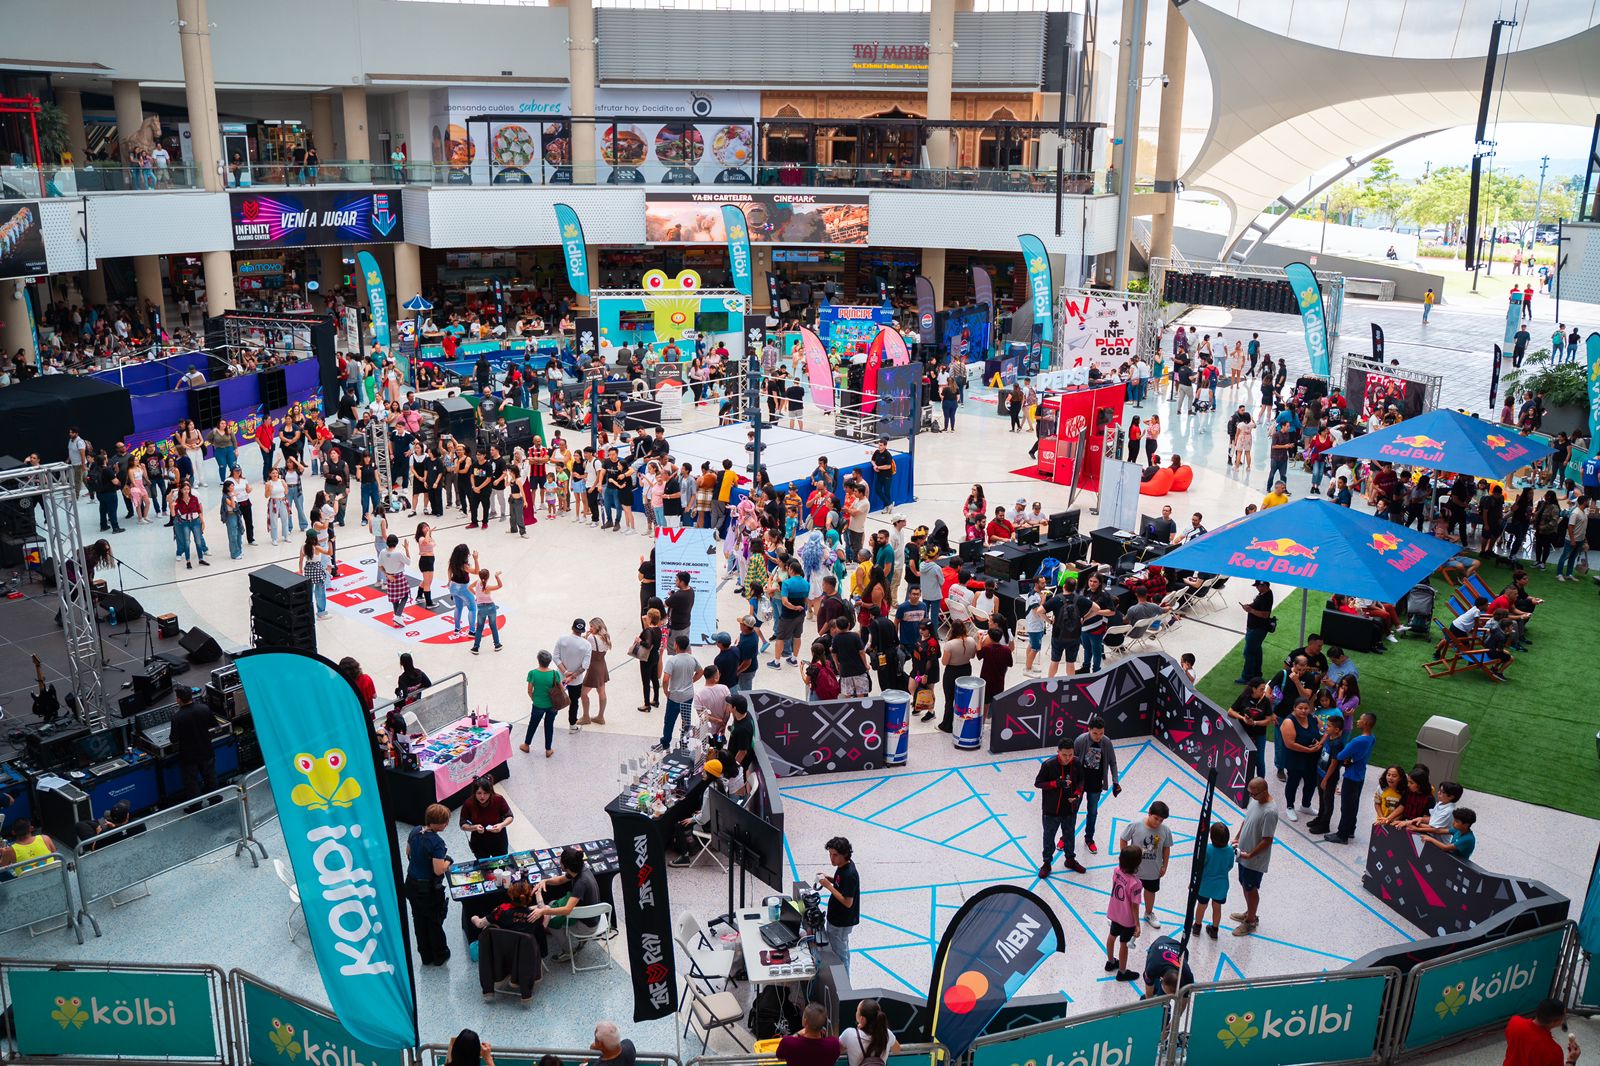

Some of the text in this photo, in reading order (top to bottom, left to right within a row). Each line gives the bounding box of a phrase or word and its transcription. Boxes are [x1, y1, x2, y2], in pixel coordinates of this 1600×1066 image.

[853, 42, 929, 62] TAJ MAHA
[488, 103, 515, 112] cuáles
[518, 100, 561, 113] sabores
[595, 103, 623, 112] isfrutar
[624, 103, 641, 114] hoy.
[642, 103, 674, 112] Decidite
[774, 195, 815, 203] CINEMARK
[280, 208, 358, 229] VENÍ A JUGAR
[235, 223, 270, 235] INFINITY
[1104, 329, 1124, 338] INF
[1109, 320, 1120, 328] #
[1095, 338, 1135, 347] PLAY
[1100, 347, 1130, 356] 2024
[1379, 444, 1445, 463] Red Bull
[1586, 464, 1594, 475] 10
[1228, 552, 1319, 578] Red Bull
[1111, 881, 1125, 901] 10
[641, 933, 670, 1010] INF PLAY
[1467, 960, 1538, 1006] kölbi
[91, 997, 177, 1026] kölbi
[1262, 1004, 1353, 1040] kölbi
[303, 1030, 379, 1066] kölb
[1046, 1036, 1133, 1066] kölbi
